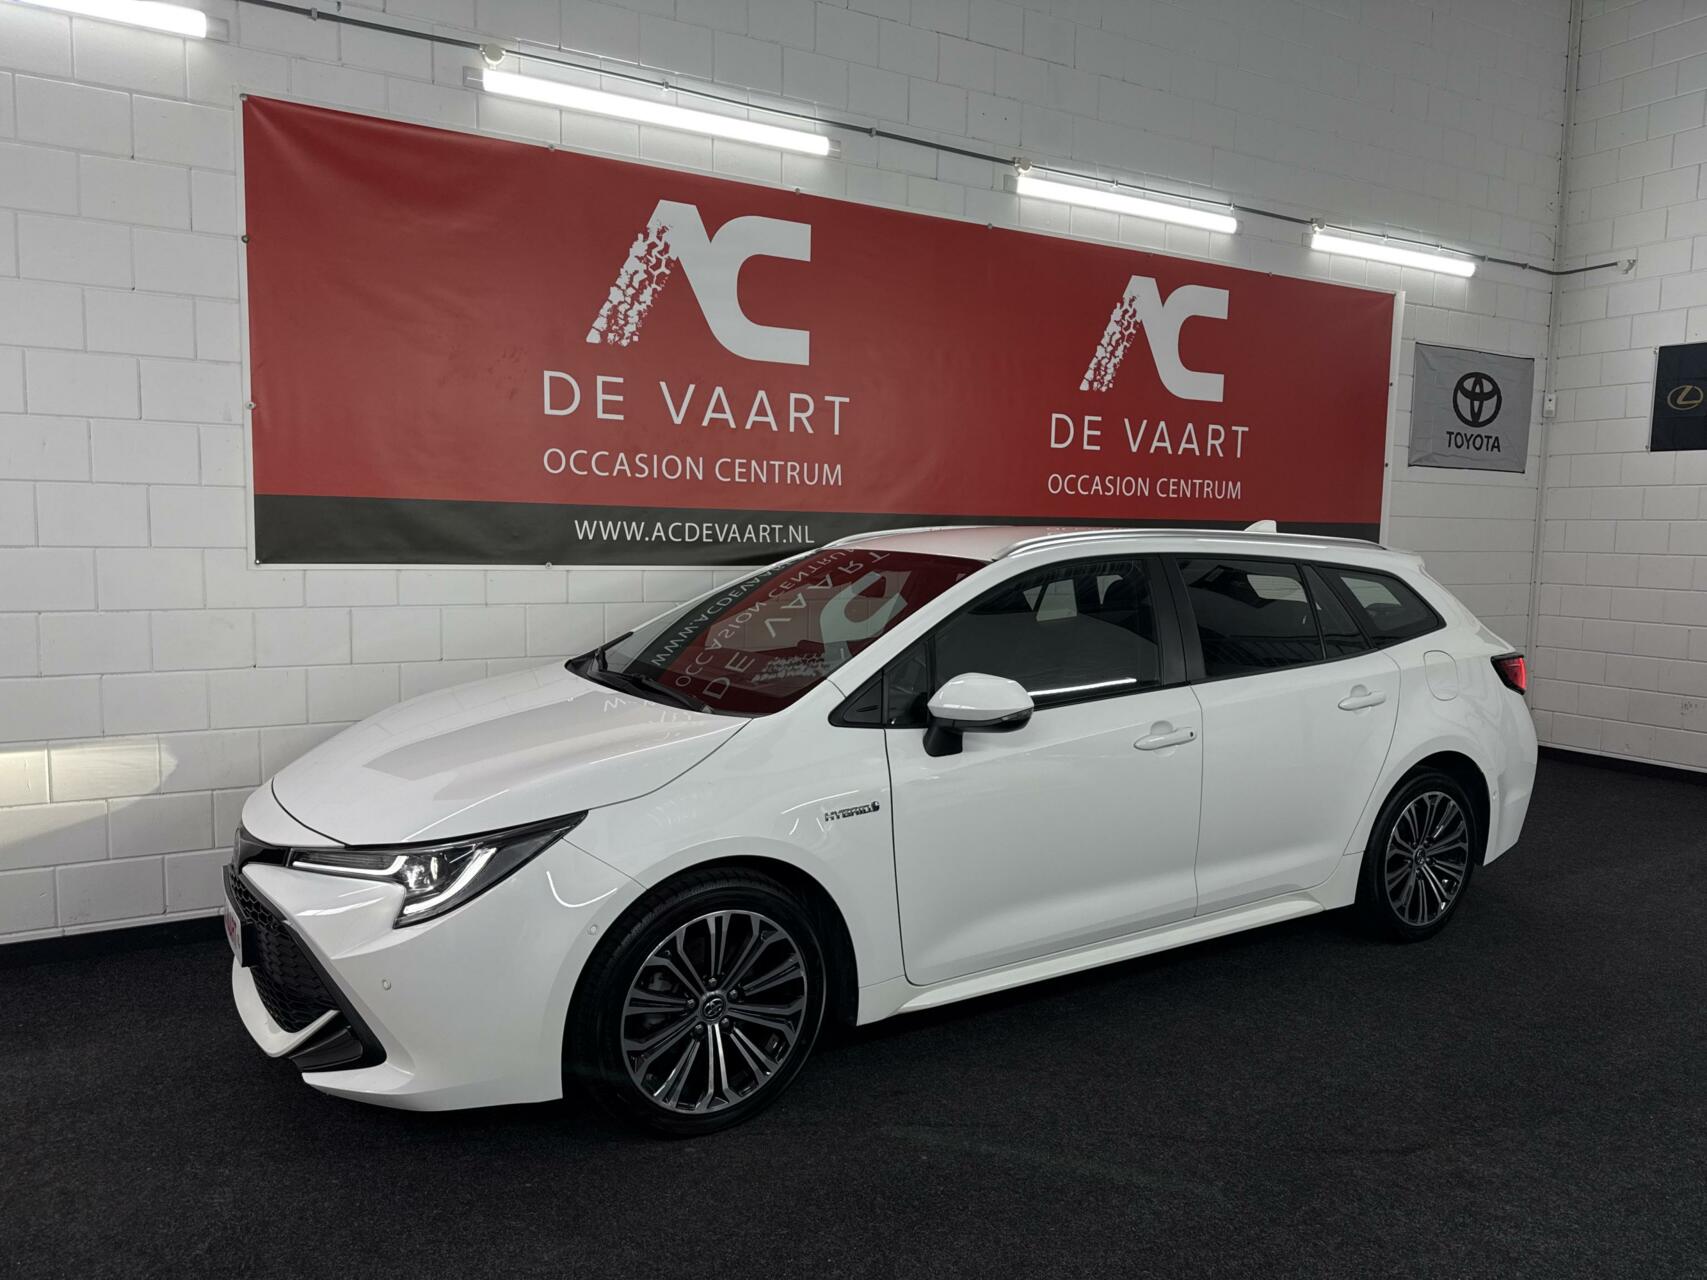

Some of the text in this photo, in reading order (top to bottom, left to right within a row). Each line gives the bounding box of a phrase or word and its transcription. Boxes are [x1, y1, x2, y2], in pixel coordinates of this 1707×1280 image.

[543, 370, 850, 436] DE VAART
[1050, 413, 1249, 459] DE VAART
[1446, 431, 1501, 452] TOYOTA
[543, 448, 842, 486] OCCASION CENTRUM
[1048, 473, 1242, 500] OCCASION CENTRUM
[574, 519, 816, 544] WWW.ACDEVAART.NL
[824, 804, 872, 821] HYBRID
